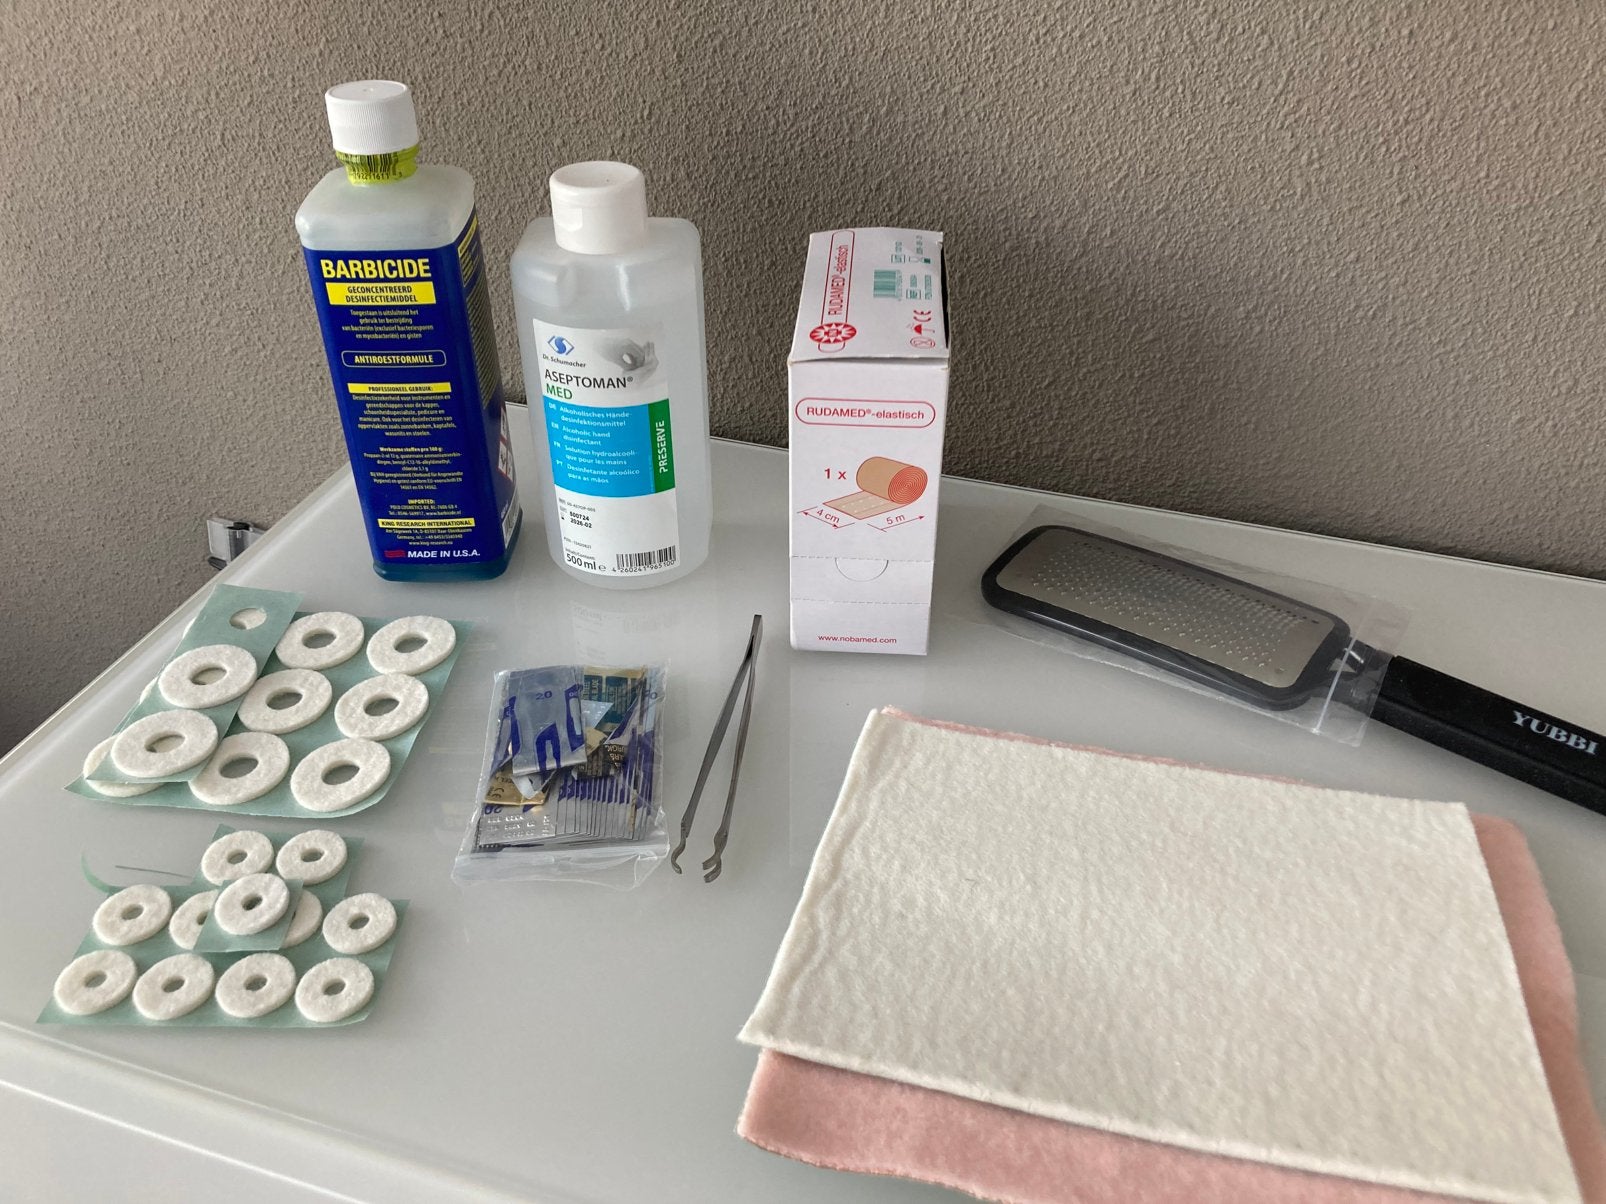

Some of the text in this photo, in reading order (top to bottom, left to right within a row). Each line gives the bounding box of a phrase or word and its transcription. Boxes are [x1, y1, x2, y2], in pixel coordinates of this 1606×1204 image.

[320, 258, 432, 279] BARBICIDE
[347, 286, 412, 294] GECONCENTREERD
[345, 294, 418, 303] DESINFECTIEMIDDEL
[354, 355, 434, 364] ANTIROESTFORMULE
[550, 356, 586, 368] Schumacher
[546, 383, 573, 400] MED
[560, 406, 605, 418] Alkoholisches
[561, 415, 626, 427] desinfektionsmittel
[562, 425, 591, 437] Alcoholic
[563, 435, 601, 446] disinfectant
[564, 445, 590, 456] Solution
[656, 420, 668, 473] PRESERVE
[579, 457, 593, 465] pour
[566, 463, 607, 476] Desinfetante
[609, 468, 640, 476] alcoólico
[824, 468, 847, 480] 1 x
[568, 473, 581, 482] para
[824, 512, 840, 523] cm
[886, 514, 905, 525] 5 m
[408, 549, 480, 558] MADE IN U.S.A.
[567, 553, 582, 566] 500
[584, 561, 597, 570] ml
[818, 635, 897, 644] www.nobamed.com
[535, 690, 553, 700] 20
[1512, 710, 1599, 755] YUBBI
